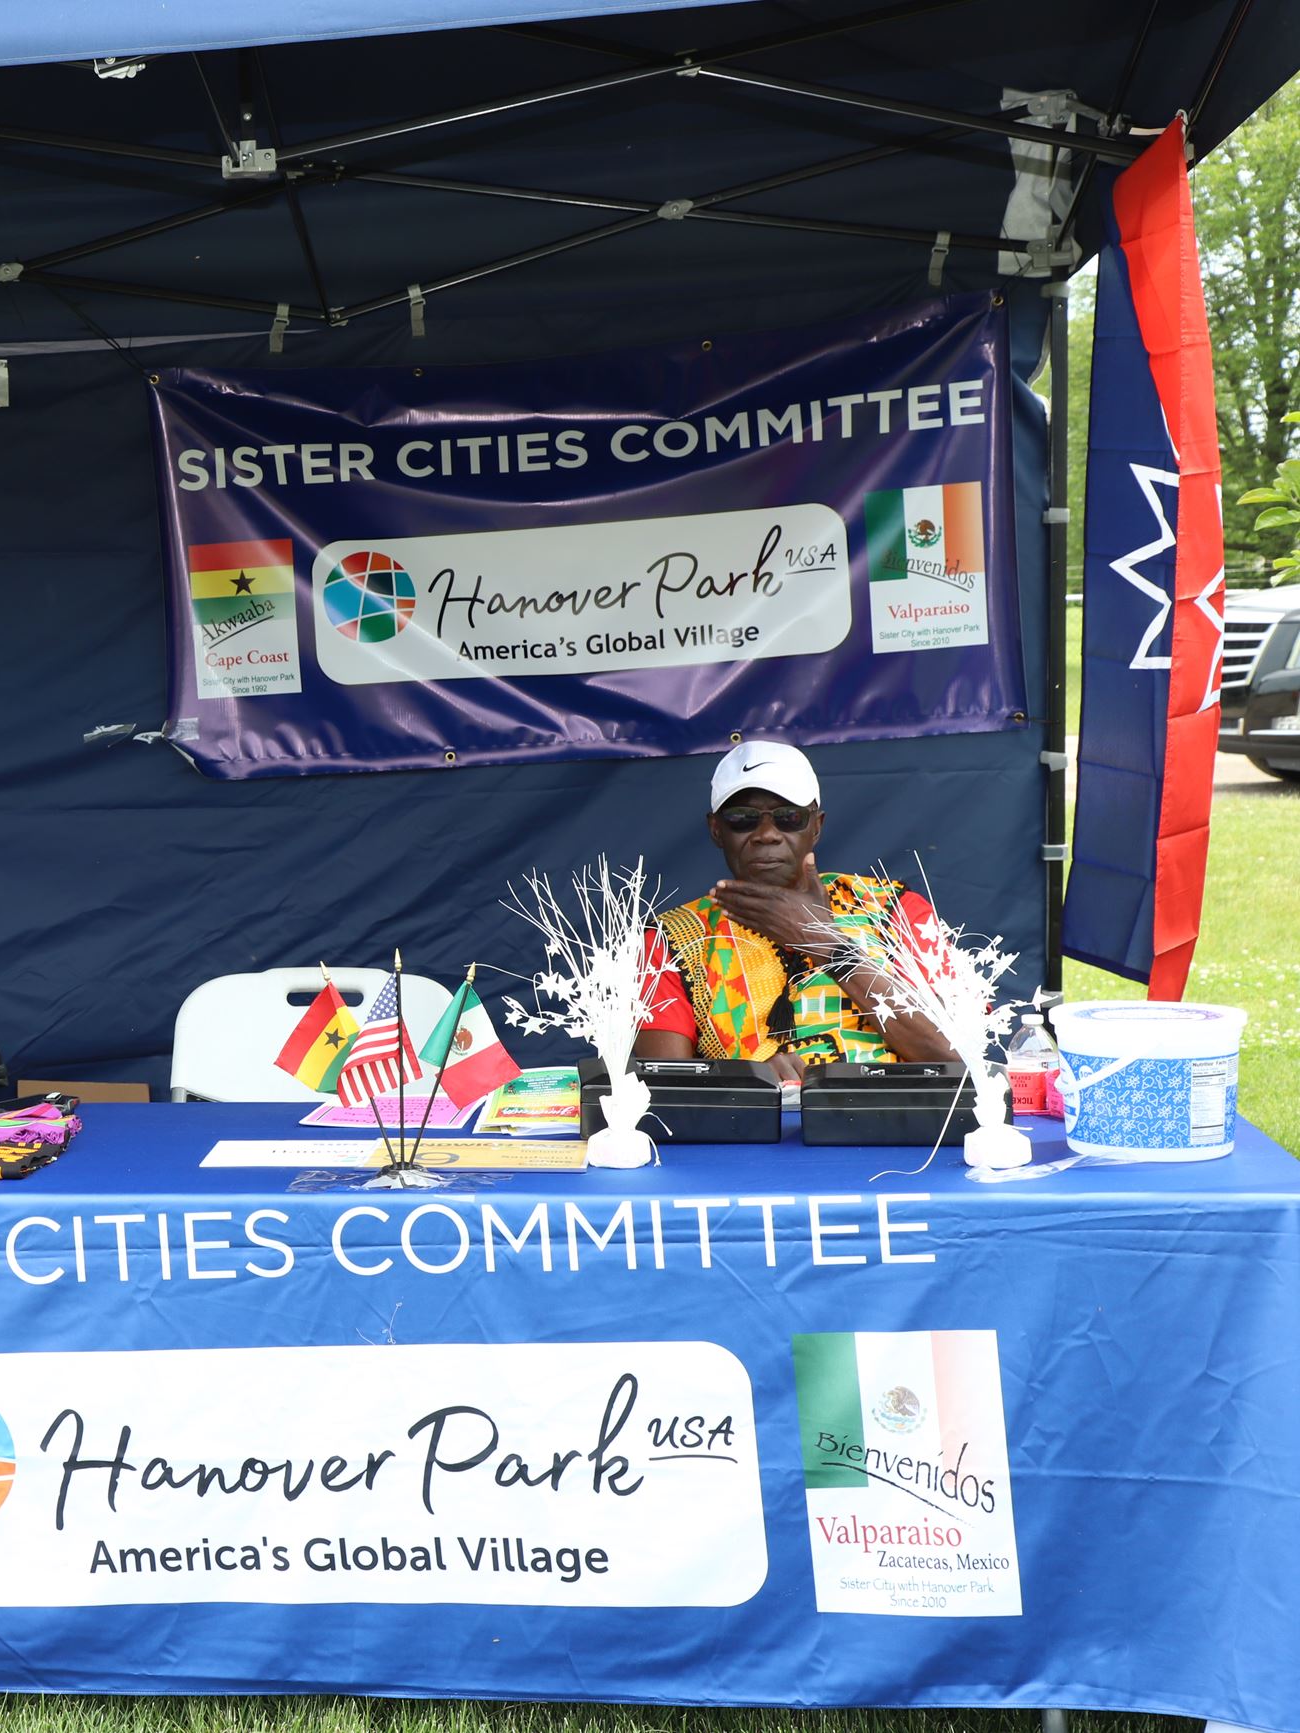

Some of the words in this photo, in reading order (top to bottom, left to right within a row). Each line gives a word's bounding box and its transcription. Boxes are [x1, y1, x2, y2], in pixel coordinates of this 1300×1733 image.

[178, 443, 376, 491] SISTER
[397, 430, 588, 479] CITIES
[610, 379, 985, 462] COMMITTEE
[784, 543, 837, 568] USA
[884, 551, 976, 589] Bienvenidos
[428, 568, 641, 638] Hanover
[647, 524, 783, 619] Park
[202, 600, 276, 645] Akwaaba
[887, 600, 970, 622] Valparaiso
[585, 629, 665, 655] Global
[673, 624, 760, 648] Village
[879, 631, 900, 640] Sister
[901, 629, 916, 639] City
[916, 628, 931, 636] with
[932, 625, 962, 635] Hanover
[963, 624, 981, 632] Park
[205, 652, 243, 671] Cape
[247, 650, 290, 665] Coast
[222, 677, 235, 686] City
[237, 675, 250, 684] with
[251, 674, 279, 684] Hanover
[279, 673, 295, 682] Park
[232, 685, 250, 694] Since
[251, 684, 268, 693] 1992
[1012, 1096, 1033, 1105] TICKE
[4, 1209, 296, 1286] CITIES
[331, 1192, 937, 1277] COMMITTEE
[646, 1415, 735, 1450] USA
[39, 1408, 398, 1532] Hanover
[407, 1372, 646, 1516] Park
[815, 1431, 995, 1513] Bienvenidos
[816, 1515, 962, 1553] Valparaiso
[89, 1536, 291, 1575] America's
[303, 1536, 447, 1573] Global
[456, 1537, 610, 1584] Village
[876, 1550, 953, 1572] Zacatecas,
[956, 1552, 1010, 1570] Mexico
[839, 1577, 870, 1590] Sister
[872, 1578, 896, 1593] City
[897, 1577, 919, 1592] with
[921, 1578, 968, 1593] Hanover
[970, 1579, 995, 1593] Park
[890, 1595, 920, 1608] Since
[921, 1596, 948, 1609] 2010
